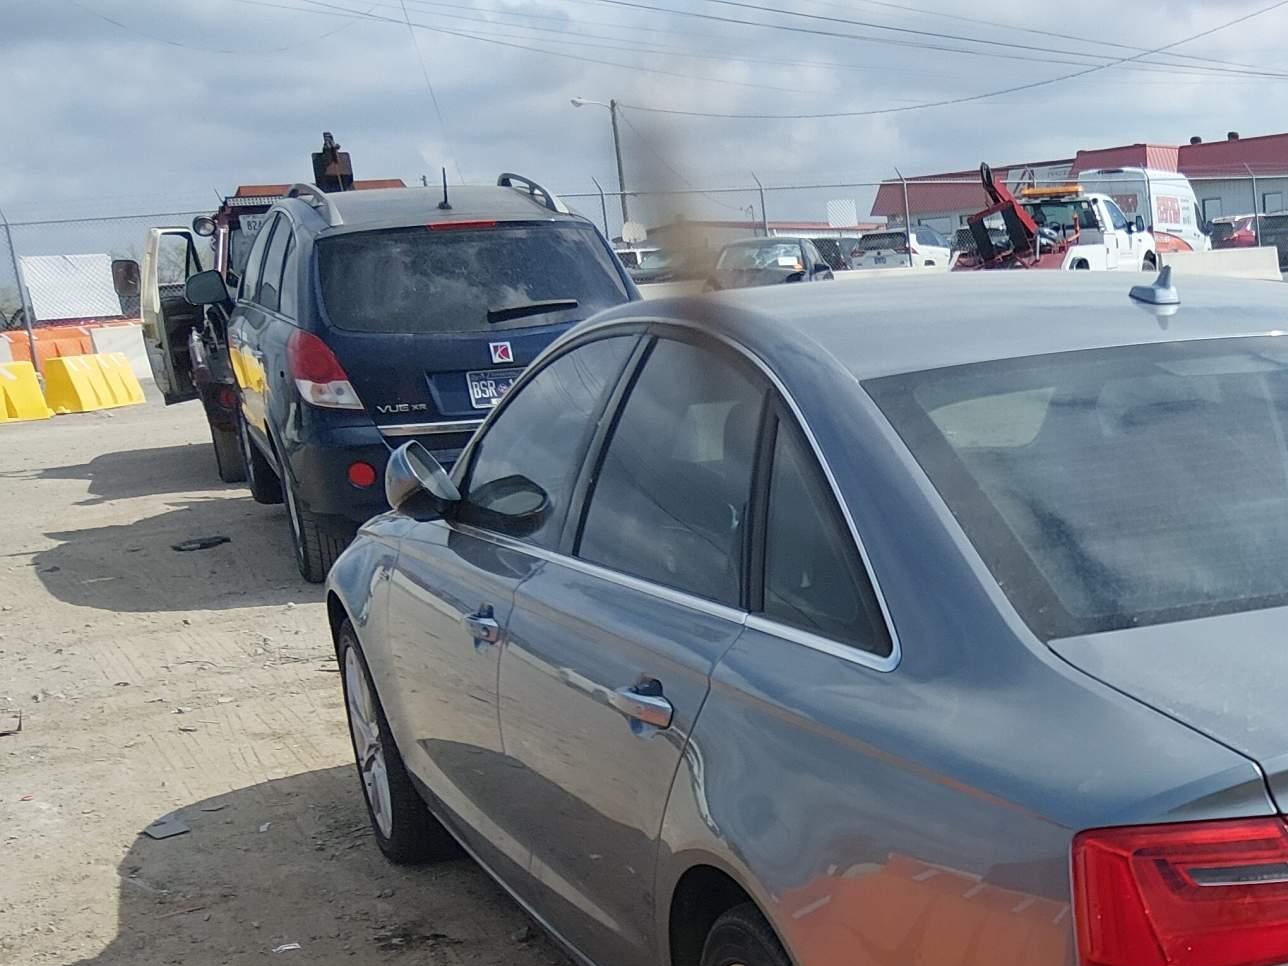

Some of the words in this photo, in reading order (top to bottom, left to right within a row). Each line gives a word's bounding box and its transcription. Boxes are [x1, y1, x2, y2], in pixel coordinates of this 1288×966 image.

[472, 380, 498, 399] BSR
[376, 403, 410, 414] VUE
[411, 403, 428, 411] XR
